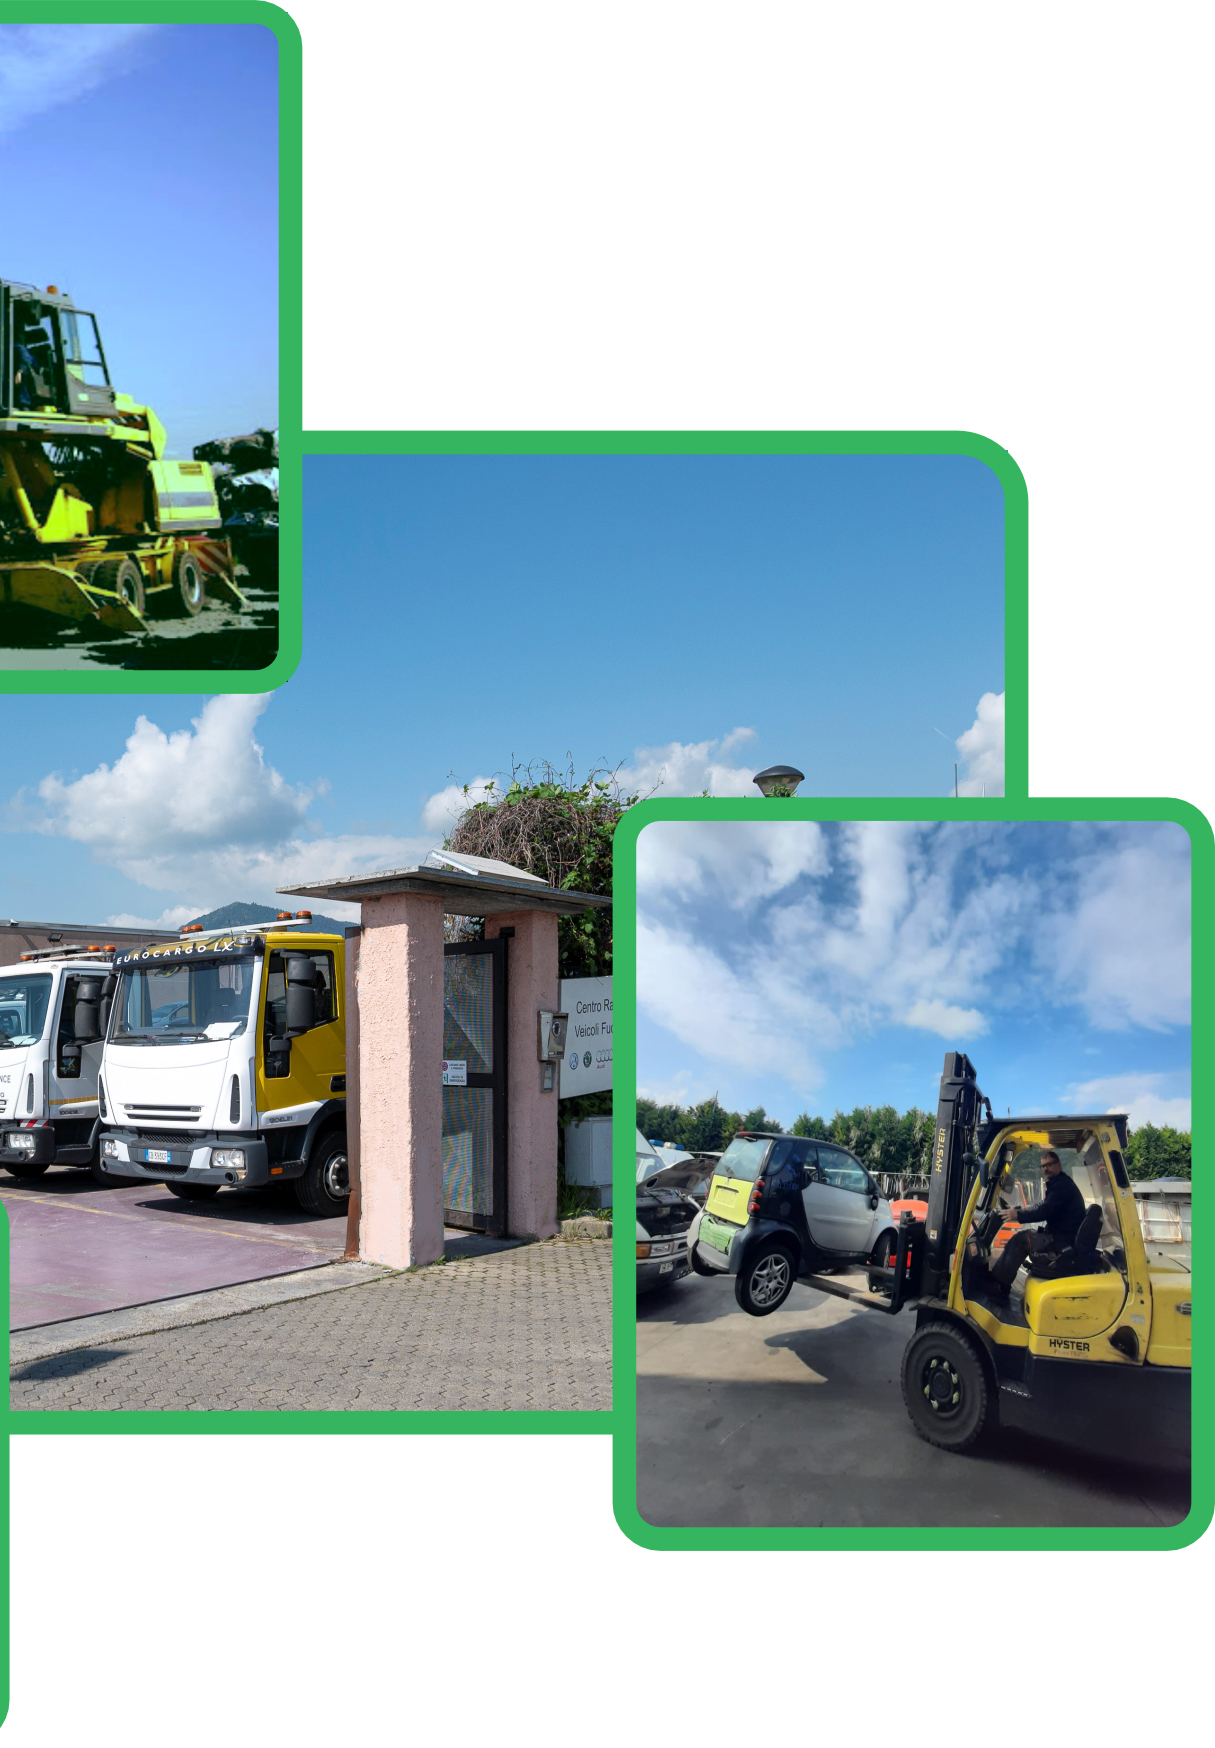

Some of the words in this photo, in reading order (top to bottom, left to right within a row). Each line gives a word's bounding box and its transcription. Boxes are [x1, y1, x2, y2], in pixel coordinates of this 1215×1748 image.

[116, 944, 207, 965] EUROCARGO
[213, 941, 235, 953] LX
[576, 1000, 602, 1015] Centro
[574, 1022, 600, 1038] Veicoli
[935, 1127, 946, 1173] HYSTER
[1049, 1338, 1090, 1352] HYSTER
